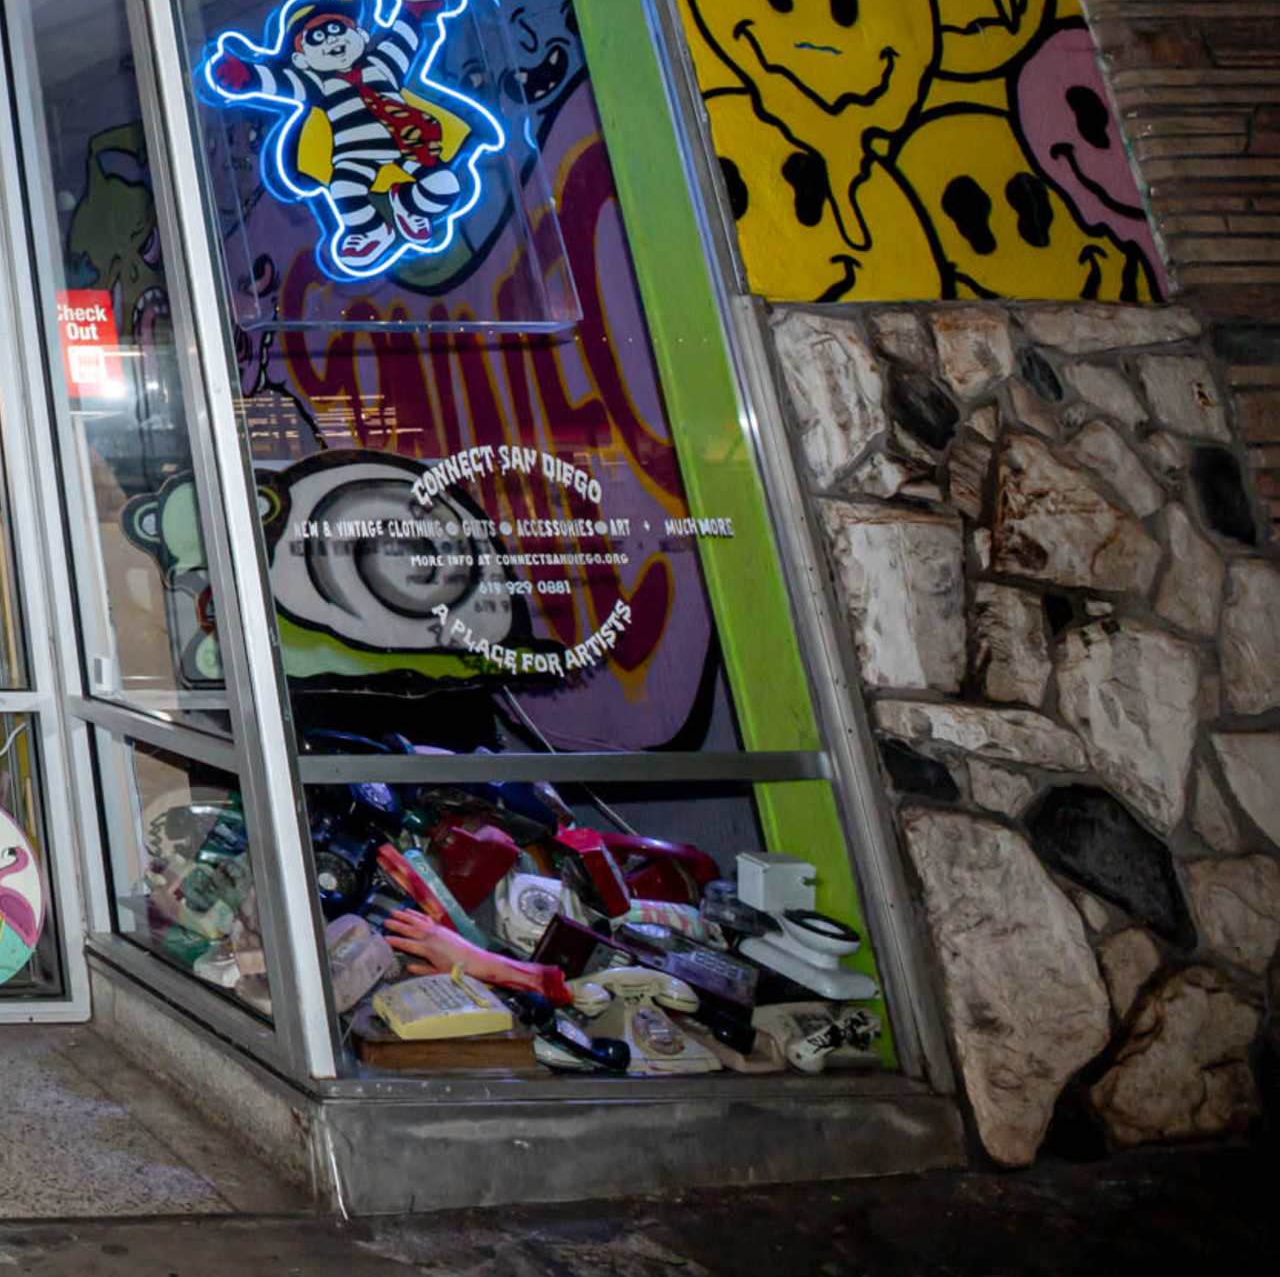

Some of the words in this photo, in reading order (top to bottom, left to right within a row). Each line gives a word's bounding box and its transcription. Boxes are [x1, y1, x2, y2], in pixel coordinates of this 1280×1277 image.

[66, 322, 99, 341] Out
[411, 445, 495, 507] CONNECT
[498, 445, 538, 476] SAN
[541, 452, 602, 505] DIEGO
[294, 521, 320, 539] NEW
[338, 520, 385, 539] VINTAGE
[388, 520, 442, 538] CLOTHING
[462, 520, 496, 537] GIFTS
[516, 519, 595, 538] ACCESSORIES
[609, 519, 630, 537] ART
[664, 518, 698, 536] MUCH
[699, 518, 735, 537] MORE
[410, 555, 443, 567] MORE
[448, 554, 474, 567] INFO
[478, 554, 491, 566] AT
[495, 554, 629, 566] CONNECTSANDIEGO.ORG
[505, 580, 533, 595] 929
[537, 580, 572, 595] 0881
[431, 603, 449, 625] A
[450, 619, 517, 675] PLACE
[521, 652, 565, 678] FOR
[564, 598, 633, 671] ARTISTS
